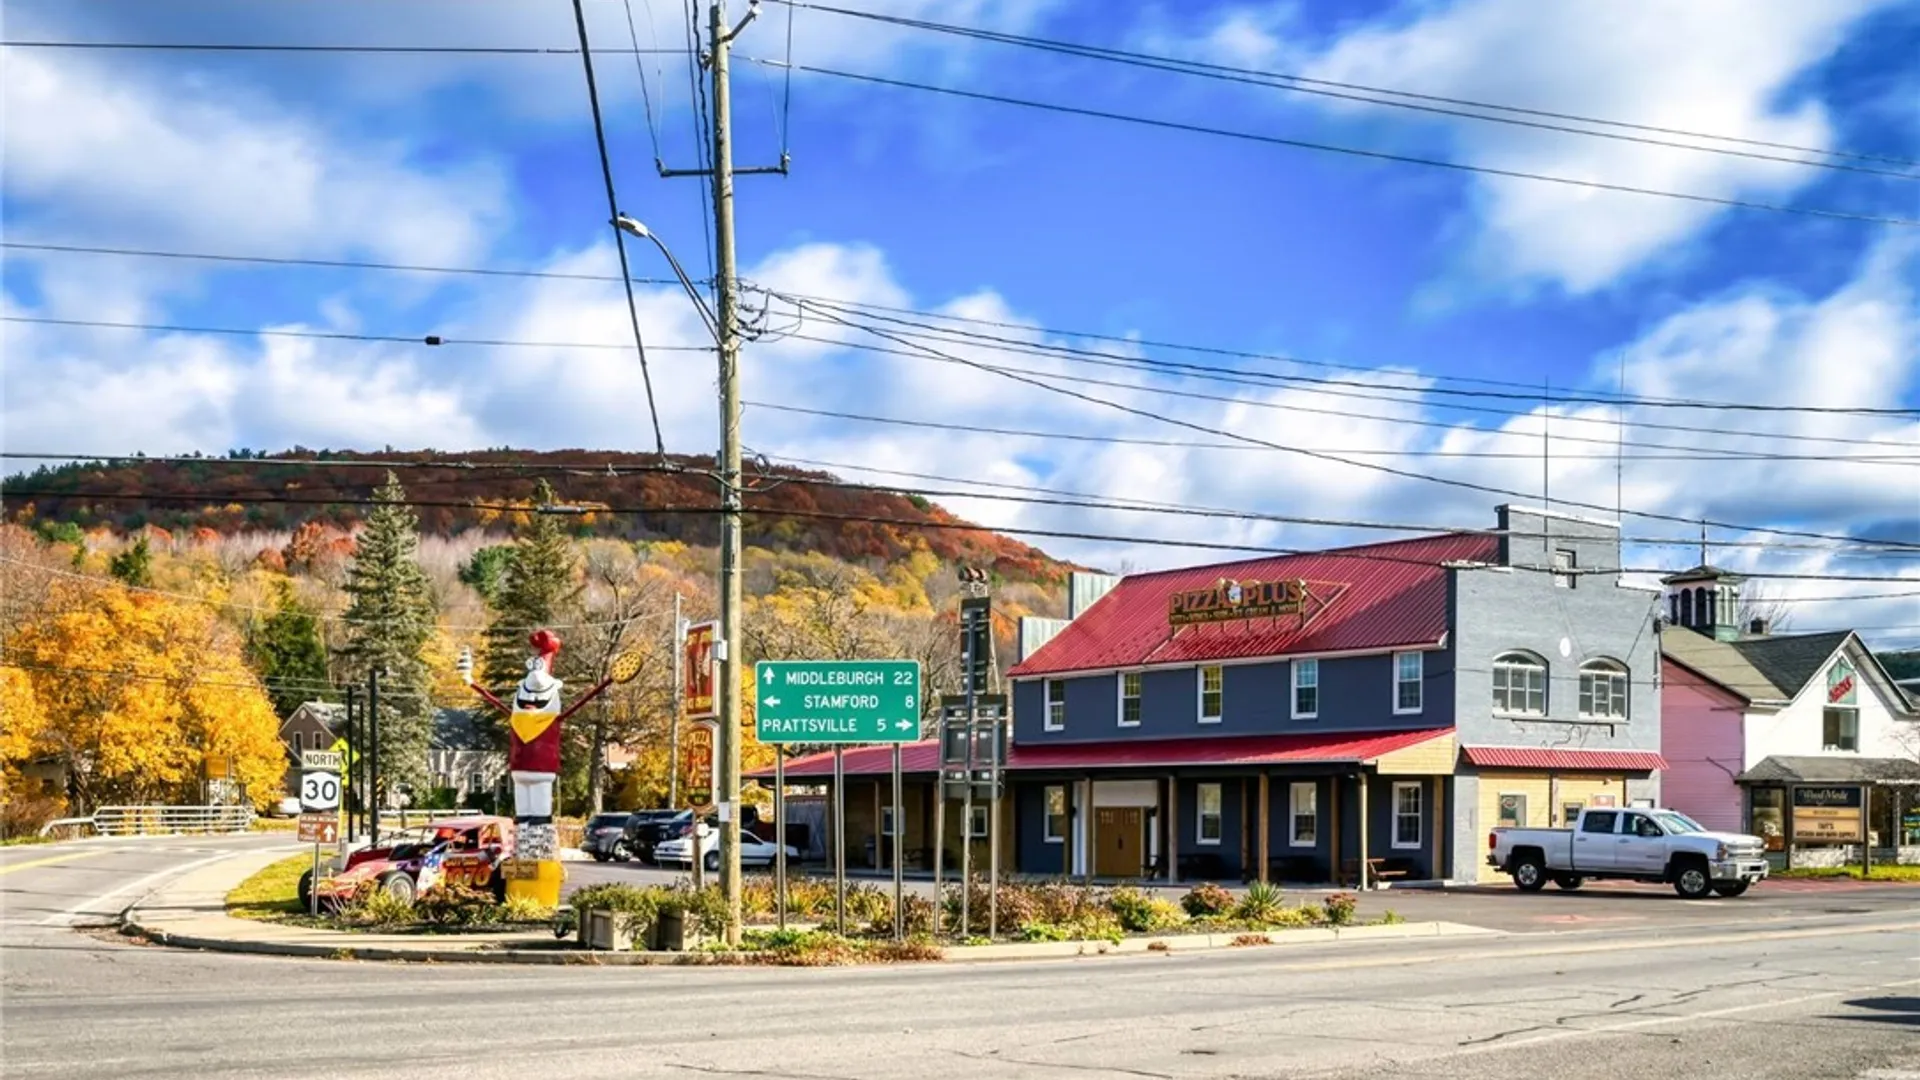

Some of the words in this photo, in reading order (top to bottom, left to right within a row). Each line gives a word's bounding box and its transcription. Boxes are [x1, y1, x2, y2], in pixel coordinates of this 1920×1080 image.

[1171, 588, 1233, 613] PIZZA
[1243, 582, 1300, 606] PLUS
[785, 671, 884, 685] MIDDLEBURGH
[894, 671, 913, 685] 22
[804, 695, 879, 709] STAMFORD
[905, 695, 914, 709] 8
[762, 718, 857, 732] PRATTSVILLE
[877, 718, 887, 732] 5
[305, 754, 341, 766] NORTH
[305, 779, 337, 801] 30
